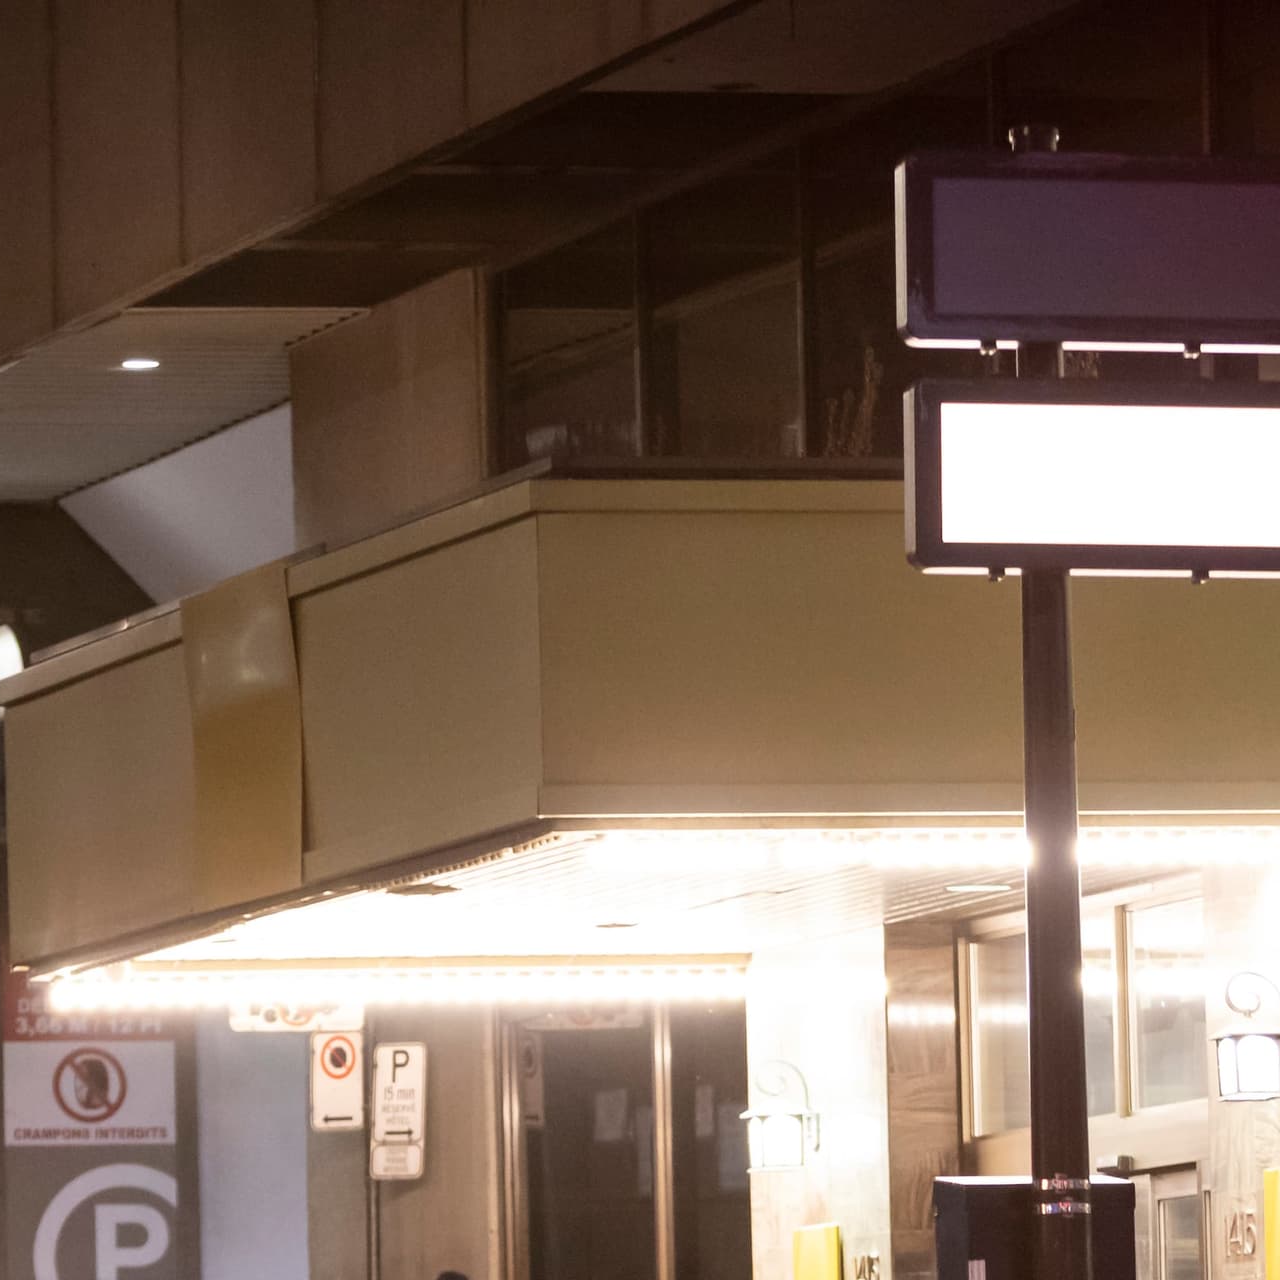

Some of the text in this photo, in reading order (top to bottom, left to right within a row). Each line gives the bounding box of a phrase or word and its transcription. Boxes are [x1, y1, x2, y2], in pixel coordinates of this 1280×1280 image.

[392, 1049, 410, 1083] P
[383, 1086, 395, 1101] 15
[13, 1126, 168, 1141] CRAMPONS INTERDITS
